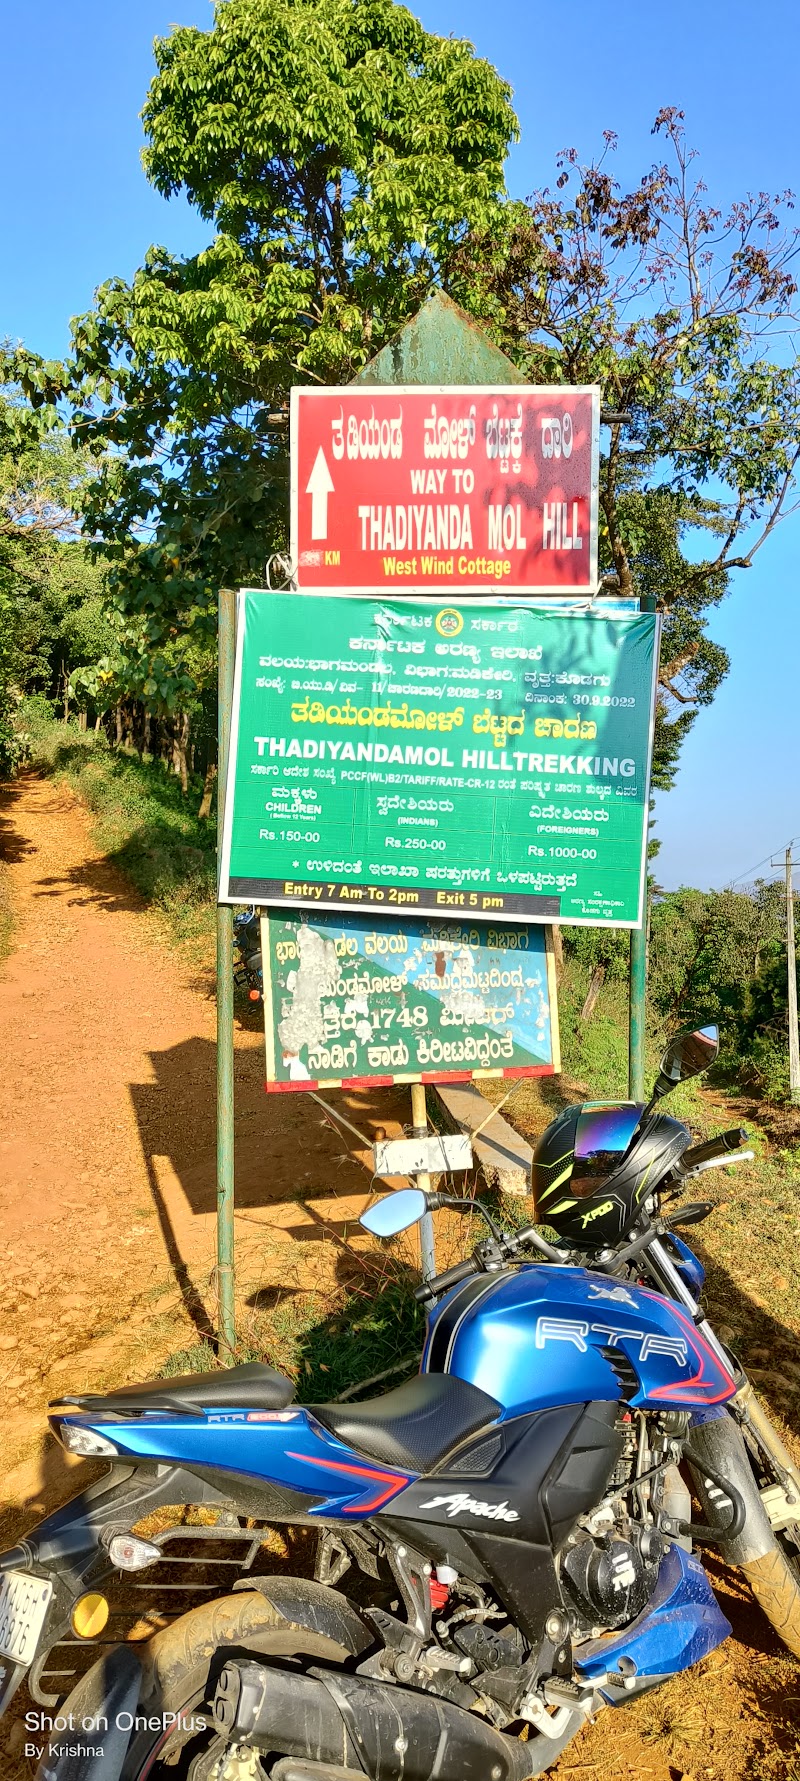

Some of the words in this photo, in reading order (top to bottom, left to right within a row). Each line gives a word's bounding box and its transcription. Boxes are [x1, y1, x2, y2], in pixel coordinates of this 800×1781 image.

[331, 404, 403, 460] ತಡಿಯಂಡ
[423, 403, 476, 459] ಮೋಳ್
[486, 403, 523, 474] ಬೆಟ್ಟಕ್ಕೆ
[541, 412, 573, 459] ದಾರಿ
[410, 470, 448, 494] WAY
[452, 469, 475, 494] TO
[358, 504, 473, 551] THADIYANDA
[488, 504, 527, 551] MOL
[542, 502, 583, 550] HILL
[325, 551, 340, 566] KM
[383, 557, 417, 576] West
[421, 556, 454, 575] Wind
[458, 555, 511, 579] Cottage
[471, 618, 518, 632] ಸರ್ಕಾರ
[349, 636, 426, 654] ಕರ್ನಾಟಕ
[434, 641, 481, 664] ಅರಣ್ಯ
[490, 645, 543, 661] ಇಲಾಖೆ
[573, 694, 636, 708] 30.9.2022
[291, 696, 464, 732] ತಡಿಯಂಡಮೋಳ್
[473, 707, 525, 748] ಬೆಟ್ಟದ
[534, 712, 597, 740] ಚಾರಣ
[254, 736, 454, 767] THADIYANDAMOL
[462, 749, 636, 777] HILLTREKKING
[341, 770, 495, 790] PCCF(WL)B2/TARIFF/RATE-CR-12
[272, 786, 317, 804] ಮಕ್ಕಳು
[376, 795, 454, 815] ಸ್ವದೇಶಿಯರು
[265, 801, 322, 814] CHILDREN
[529, 804, 609, 822] ವಿದೇಶಿಯರು
[397, 817, 439, 827] (INDIANS)
[537, 825, 600, 837] (FOREIGNERS)
[259, 829, 320, 843] Rs.150-00
[385, 837, 446, 851] Rs.250-00
[527, 845, 597, 859] Rs.1000-00
[306, 859, 363, 874] ಉಳಿದಂತೆ
[284, 882, 323, 899] Entry
[327, 885, 336, 897] 7
[340, 886, 363, 899] Am
[367, 888, 384, 900] To
[388, 889, 419, 904] 2pm
[436, 892, 464, 905] Exit
[469, 893, 478, 906] 5
[482, 896, 504, 909] pm
[365, 930, 408, 955] ವಲಯ
[487, 926, 529, 954] ವಿಭಾಗ
[370, 1005, 429, 1029] 1748
[308, 1039, 357, 1070] ನಾಡಿಗೆ
[368, 1039, 409, 1067] ಕಾಡು
[417, 1030, 514, 1067] ಕಿರೀಟವಿದ್ದಂತೆ
[535, 1316, 689, 1367] RTR
[420, 1493, 521, 1523] Apache
